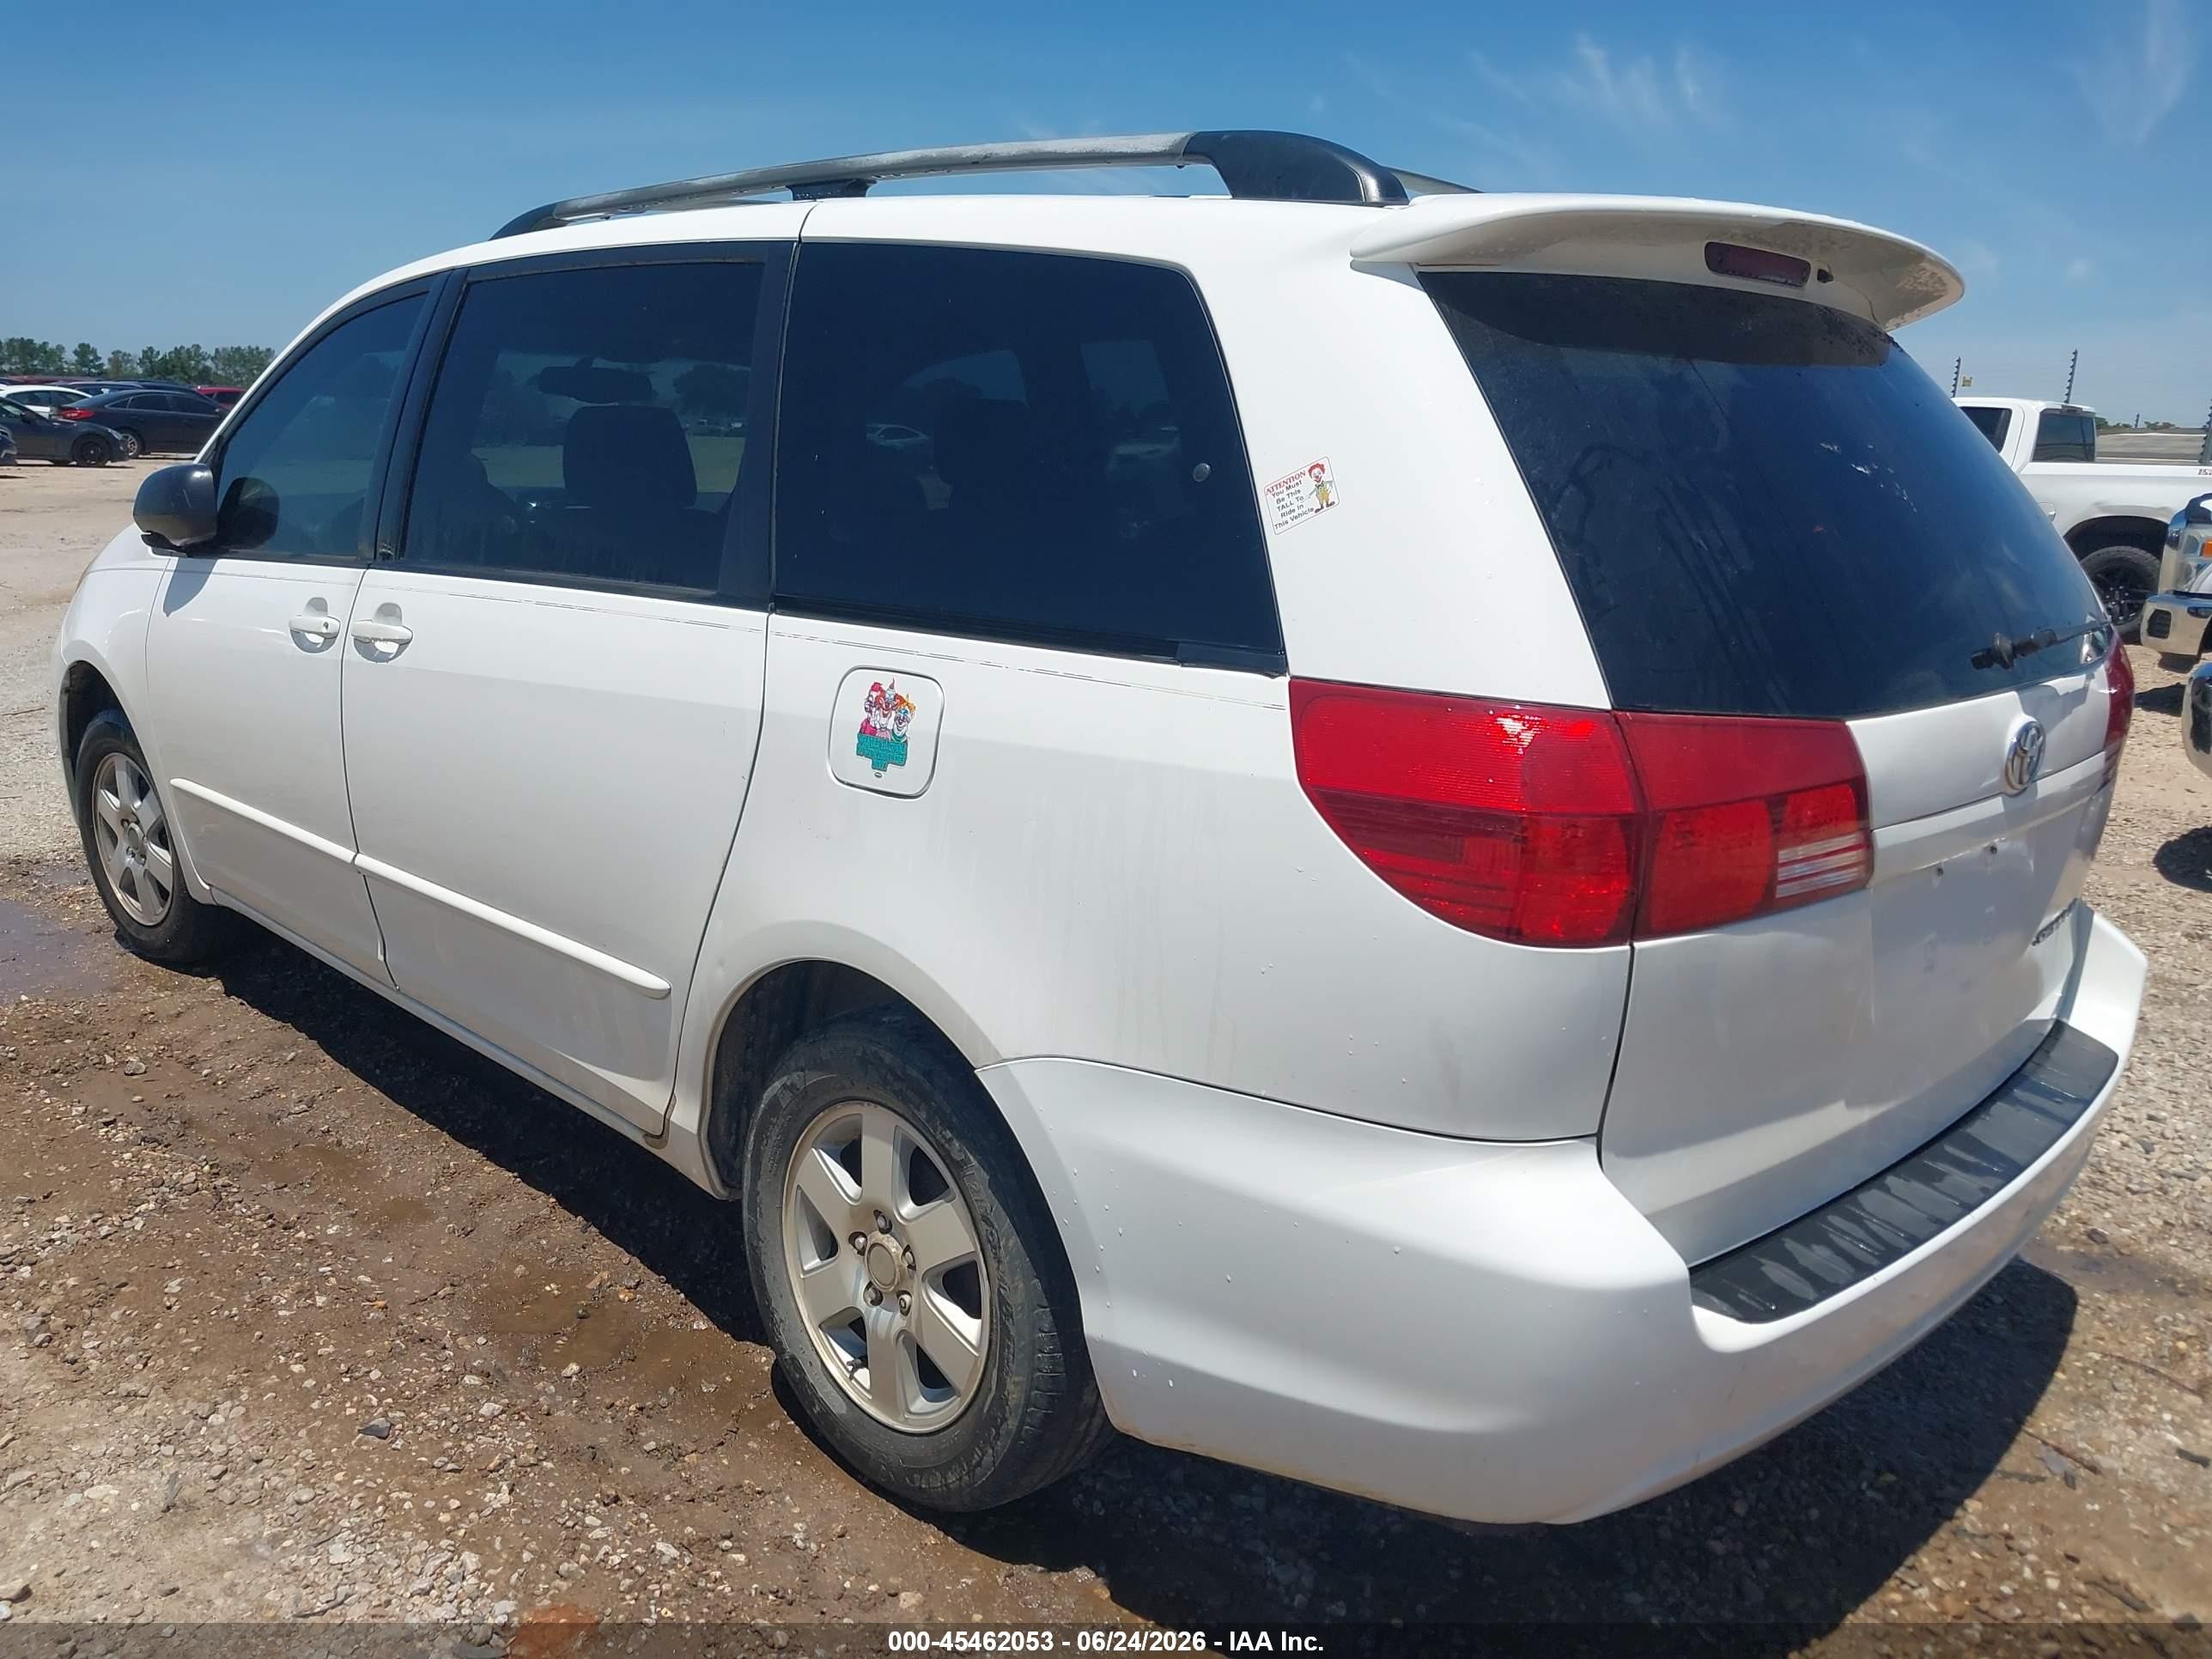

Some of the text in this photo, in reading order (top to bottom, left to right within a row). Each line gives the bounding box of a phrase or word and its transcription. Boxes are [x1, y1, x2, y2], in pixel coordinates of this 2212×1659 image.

[1267, 470, 1306, 495] ATTENTION
[1272, 480, 1302, 498] You Must
[1286, 489, 1301, 499] This
[1277, 501, 1295, 512] TALL
[1280, 508, 1295, 519] Ride
[1274, 507, 1314, 530] This Vehicle
